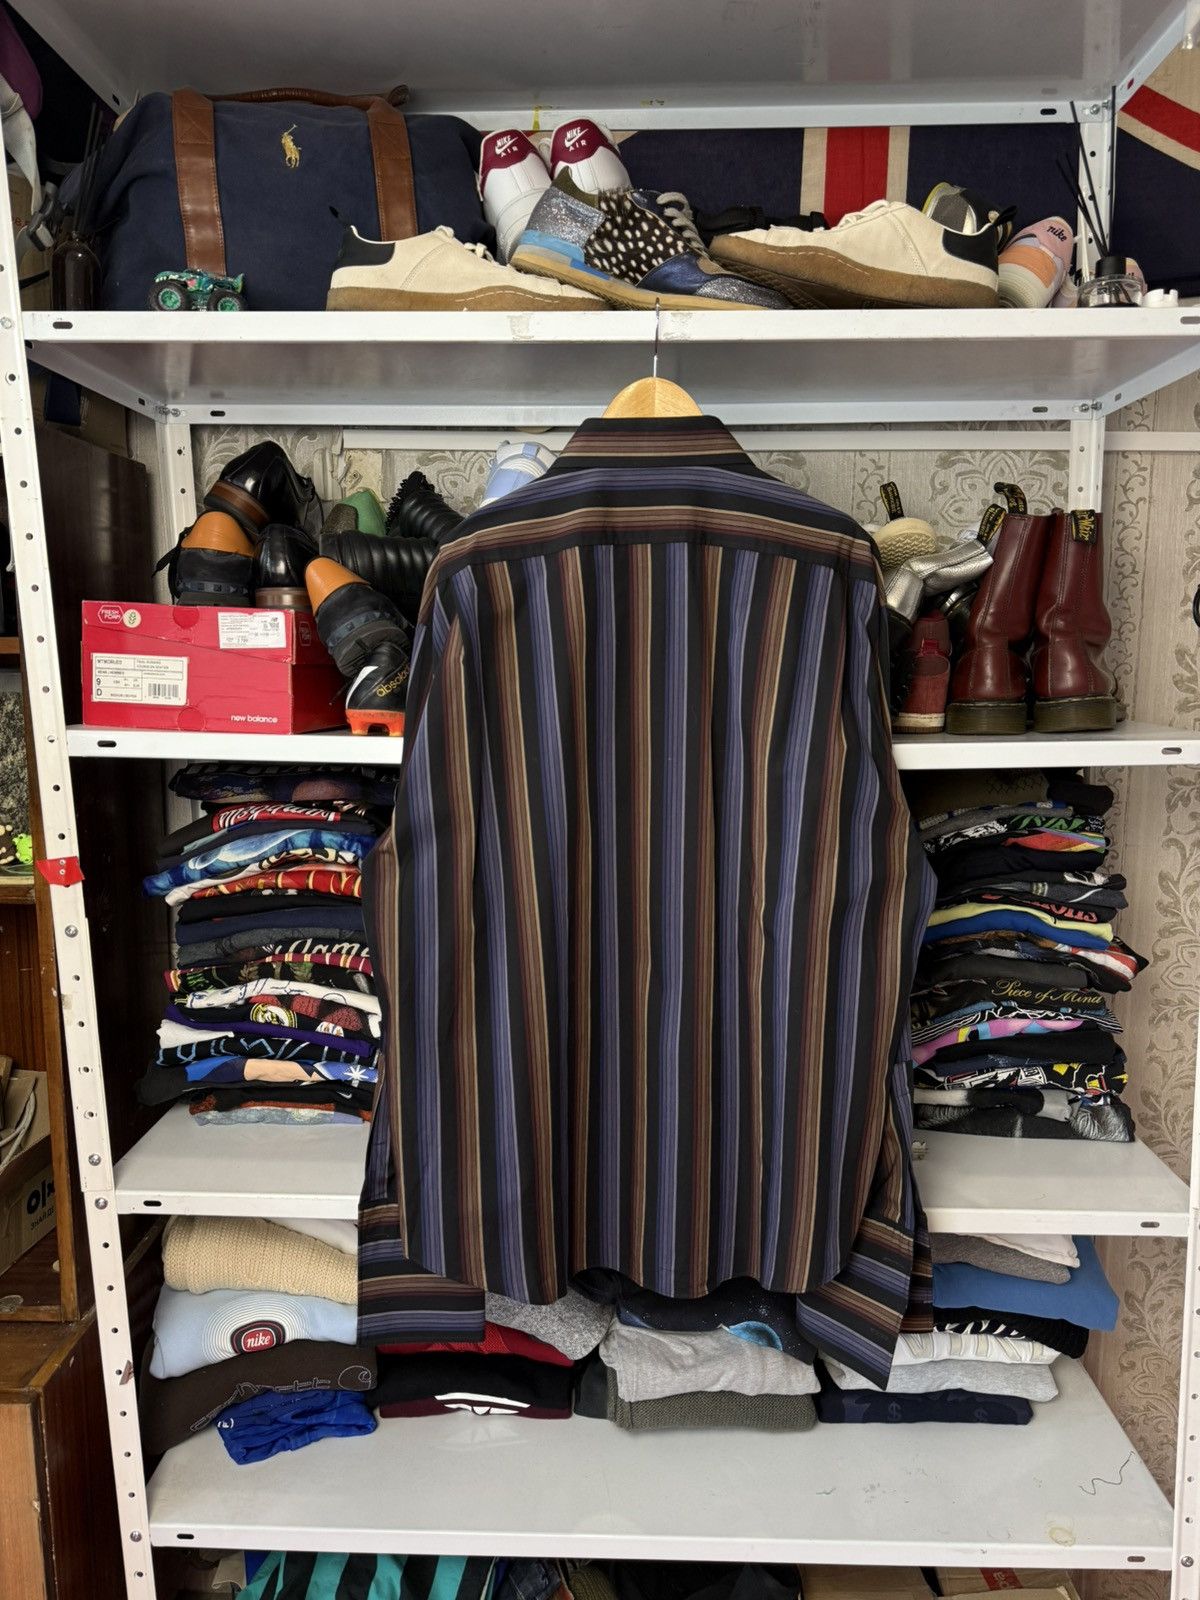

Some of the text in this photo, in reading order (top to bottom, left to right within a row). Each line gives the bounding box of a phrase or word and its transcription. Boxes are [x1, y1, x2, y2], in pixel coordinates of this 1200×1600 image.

[566, 127, 581, 140] NIKE
[496, 135, 511, 147] NIKE
[569, 140, 587, 152] AIR
[500, 146, 518, 158] AIR
[1046, 225, 1068, 242] nike
[96, 678, 102, 686] 9
[96, 688, 103, 697] D
[230, 714, 279, 724] new balance
[991, 979, 1103, 1005] Piece of Mind
[246, 1332, 271, 1348] nike
